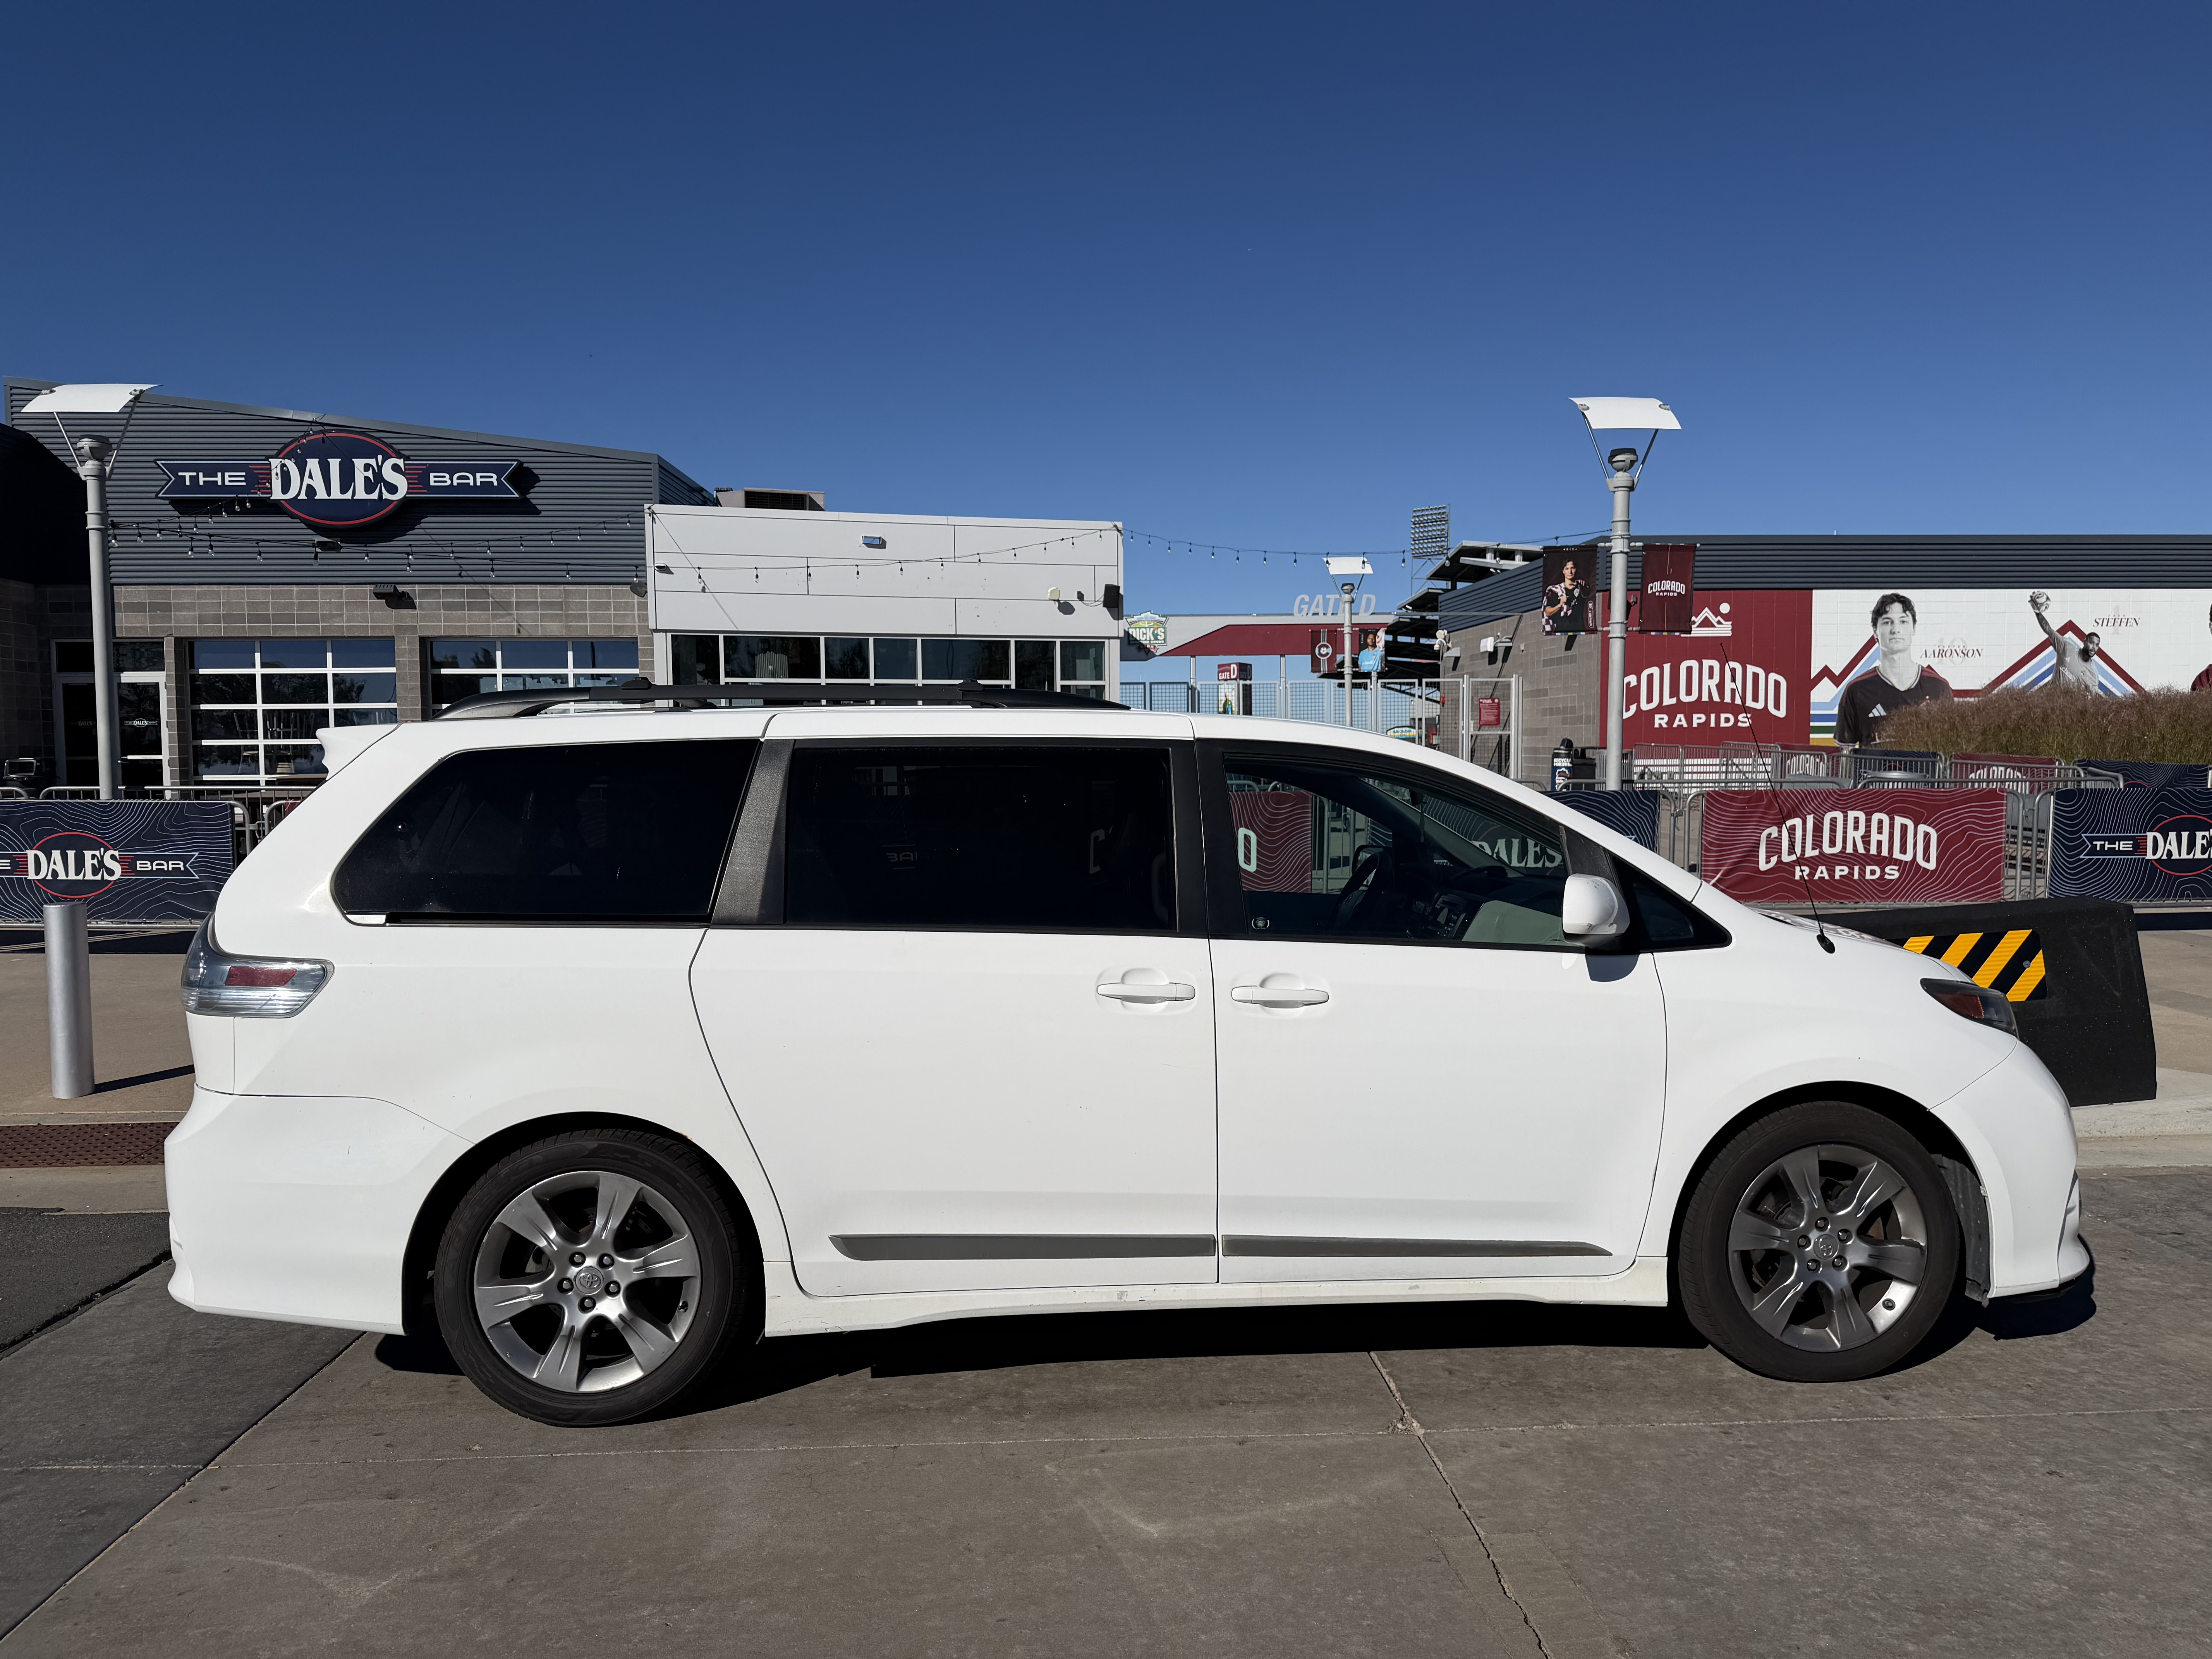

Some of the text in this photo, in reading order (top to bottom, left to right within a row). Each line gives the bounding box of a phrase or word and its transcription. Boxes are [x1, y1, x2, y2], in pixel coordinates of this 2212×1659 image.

[178, 454, 498, 500] THE DALE'S BAR
[1648, 580, 1685, 594] COLORADO
[1358, 594, 1376, 616] D
[2093, 617, 2140, 627] STEFFEN
[1128, 628, 1165, 641] DICK'S
[1920, 648, 1983, 658] AARONSON
[1230, 664, 1237, 679] D
[1623, 659, 1787, 719] COLORADO
[1654, 713, 1752, 728] RAPIDS
[1759, 810, 1937, 871] COLORADO
[2093, 841, 2133, 851] THE
[26, 847, 122, 880] DALE'S
[136, 860, 184, 871] BAR
[1795, 865, 1900, 880] RAPIDS
